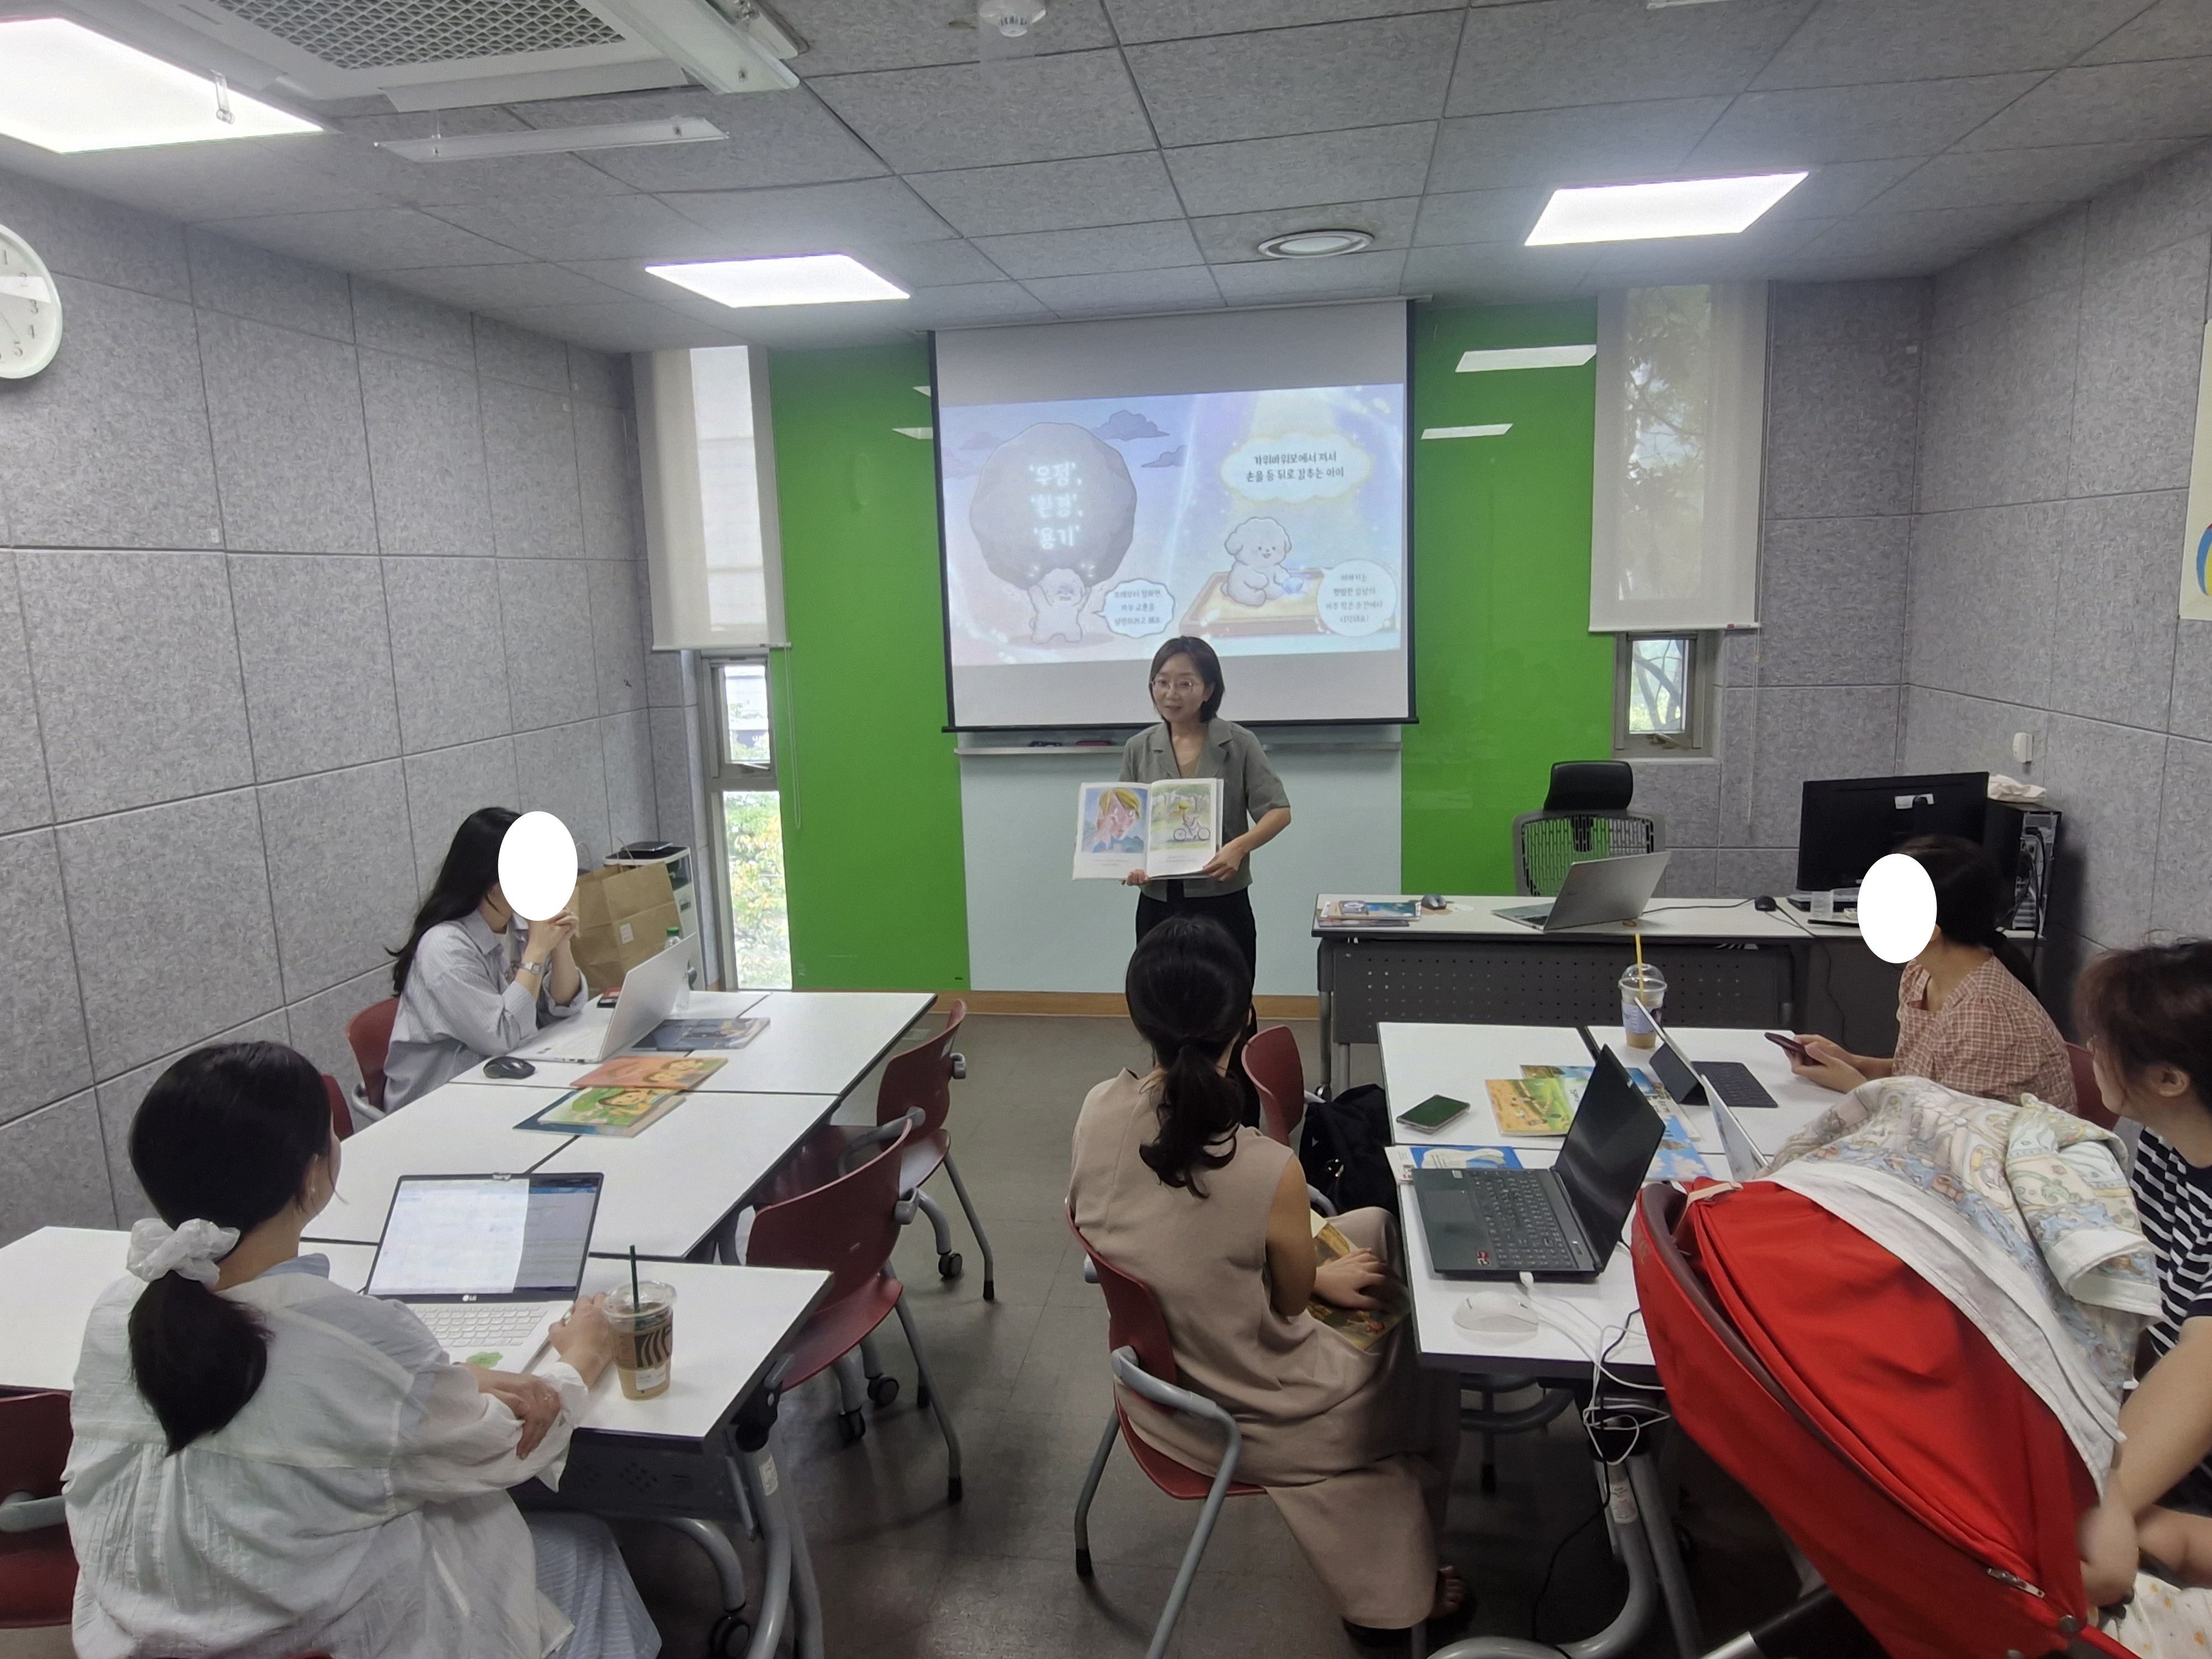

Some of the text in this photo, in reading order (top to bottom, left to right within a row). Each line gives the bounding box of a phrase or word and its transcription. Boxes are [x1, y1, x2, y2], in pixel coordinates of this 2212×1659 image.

[3, 249, 8, 265] 1
[19, 272, 28, 287] 2
[29, 298, 39, 315] 3
[13, 341, 23, 357] 5
[1254, 452, 1316, 465] 가위바위보에서
[1247, 470, 1264, 482] 손을
[1277, 469, 1294, 479] 뒤로
[1326, 466, 1344, 477] 아이
